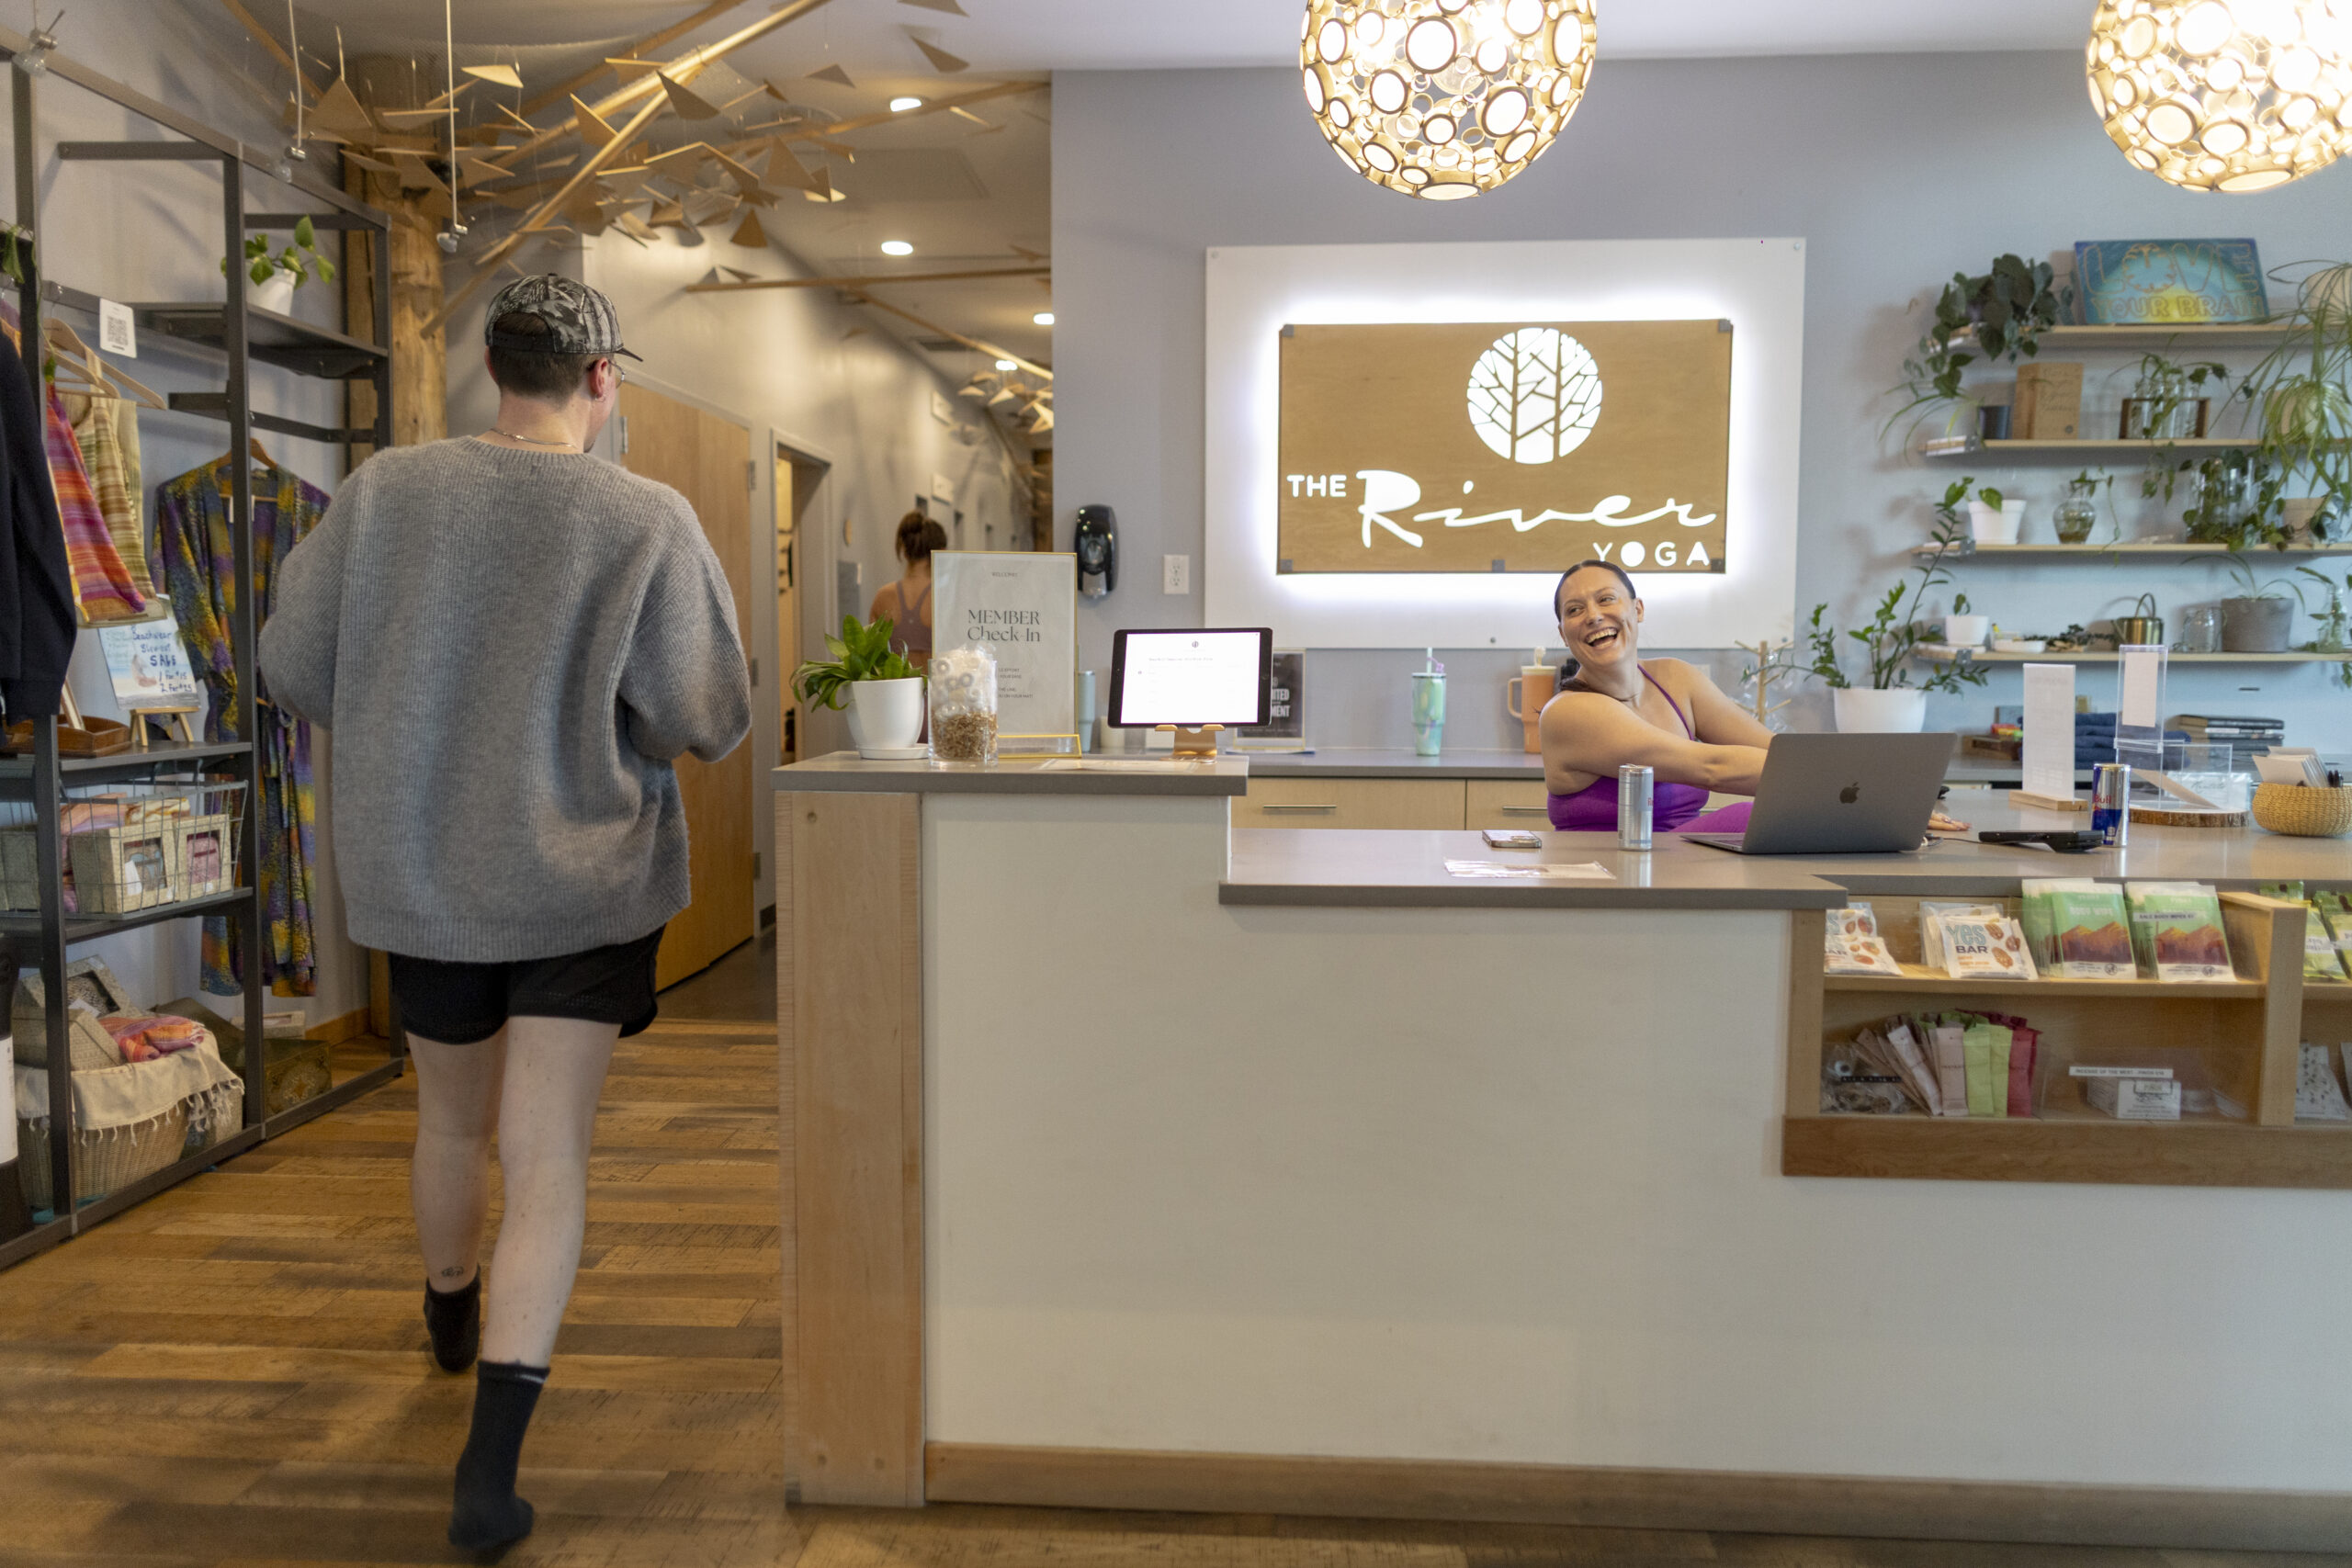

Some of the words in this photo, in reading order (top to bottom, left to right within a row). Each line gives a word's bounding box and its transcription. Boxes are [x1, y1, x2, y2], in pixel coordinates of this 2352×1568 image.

[2090, 295, 2171, 319] YOUR
[2176, 295, 2265, 318] BRAIN
[1287, 474, 1347, 497] THE
[1356, 469, 1717, 548] River
[1592, 541, 1710, 567] YOGA
[967, 609, 1040, 625] MEMBER
[967, 626, 1040, 642] Check-In
[150, 654, 176, 666] SALE
[2094, 794, 2111, 804] Bull
[1955, 945, 1988, 954] BAR
